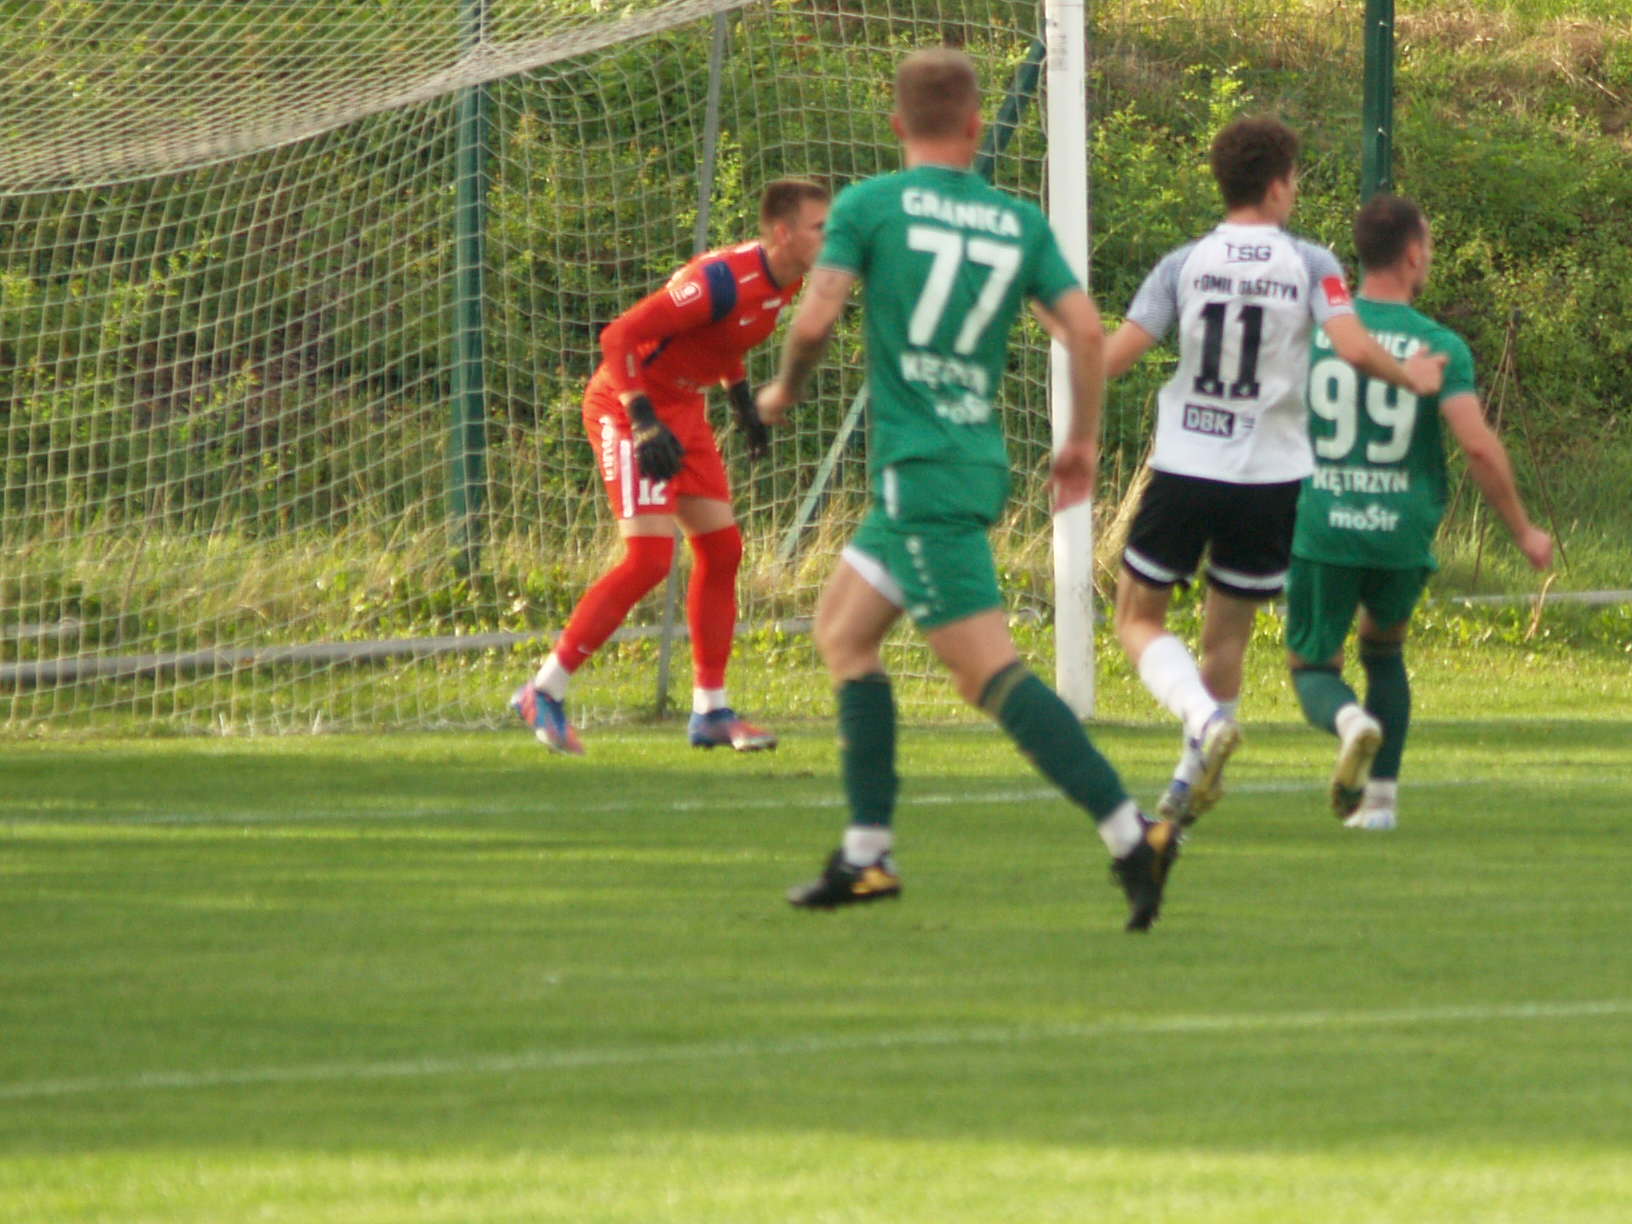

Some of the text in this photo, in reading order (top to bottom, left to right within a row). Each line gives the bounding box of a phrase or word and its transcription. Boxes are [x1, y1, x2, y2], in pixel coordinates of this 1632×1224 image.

[1225, 242, 1272, 262] TSG
[907, 224, 1022, 356] 77
[1193, 302, 1264, 400] 11
[1185, 407, 1232, 437] DBK
[1310, 356, 1418, 463] 99
[1312, 465, 1409, 497] KĘTRZYN
